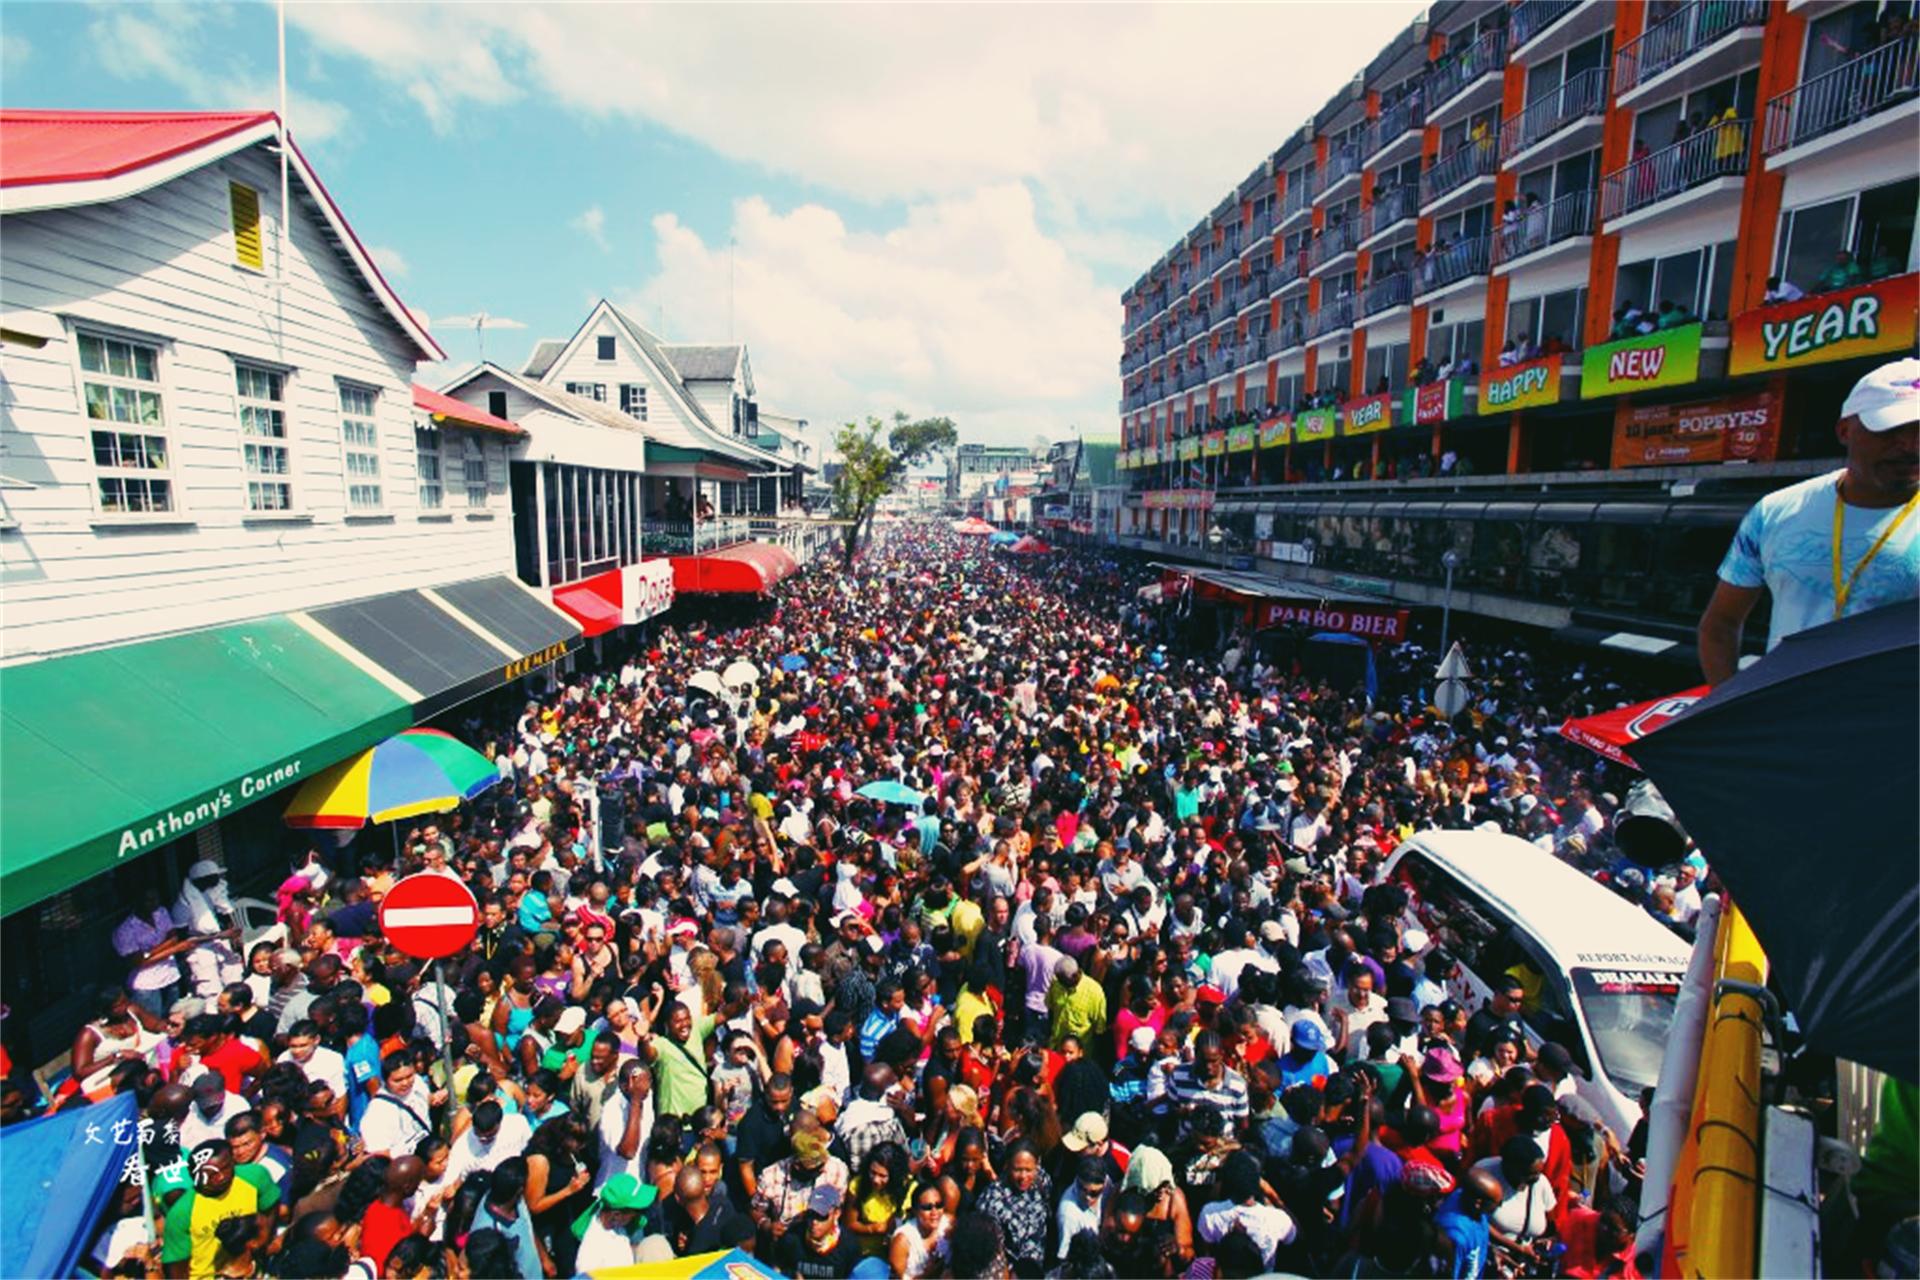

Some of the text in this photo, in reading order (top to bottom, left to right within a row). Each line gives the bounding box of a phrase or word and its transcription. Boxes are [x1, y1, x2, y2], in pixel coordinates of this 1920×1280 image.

[1762, 295, 1880, 359] YEAR
[1609, 347, 1665, 380] NEW
[1487, 367, 1549, 404] HAPPY
[1351, 400, 1382, 427] YEAR
[1679, 408, 1769, 434] POPEYES
[1269, 605, 1398, 636] PARBO BIER
[117, 759, 302, 858] Anthony's Corner
